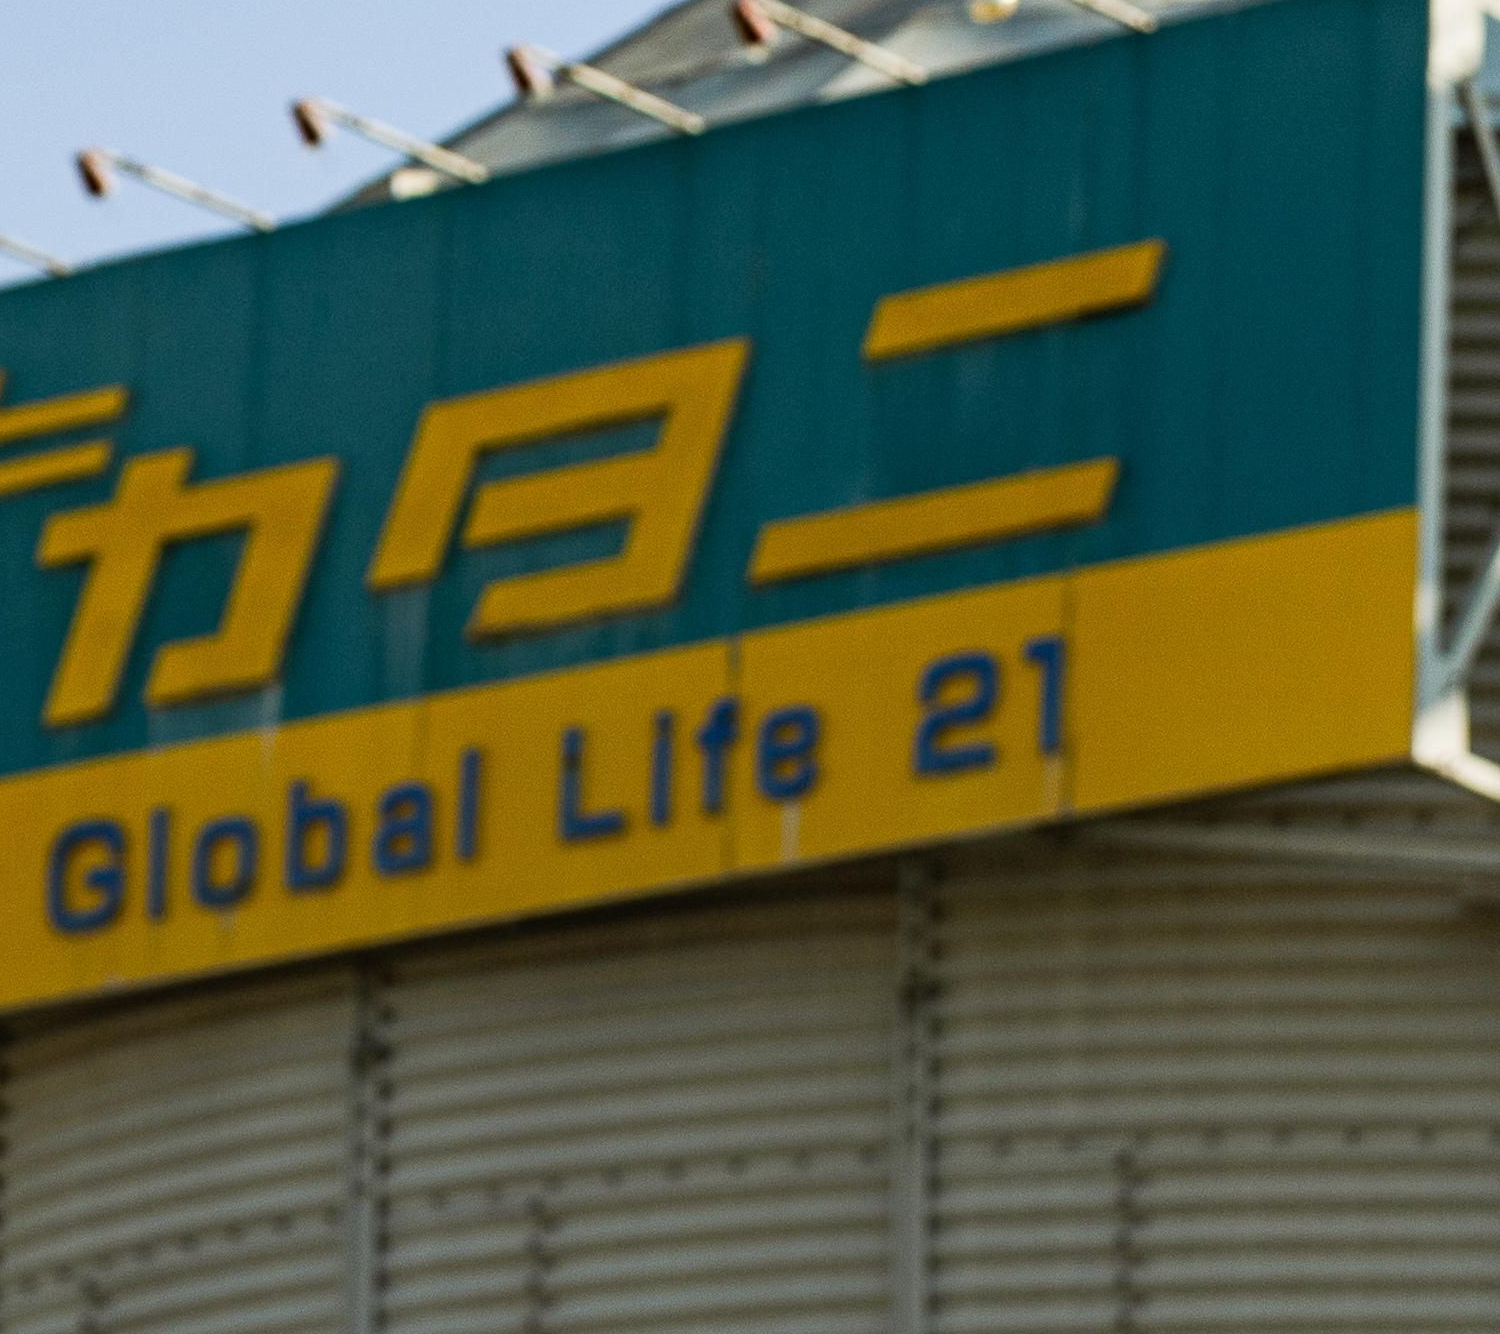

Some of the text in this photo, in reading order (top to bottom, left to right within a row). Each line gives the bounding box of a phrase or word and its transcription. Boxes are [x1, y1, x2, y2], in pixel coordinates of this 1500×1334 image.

[50, 749, 480, 933] Global
[559, 697, 821, 841] Life
[913, 636, 1067, 776] 21
